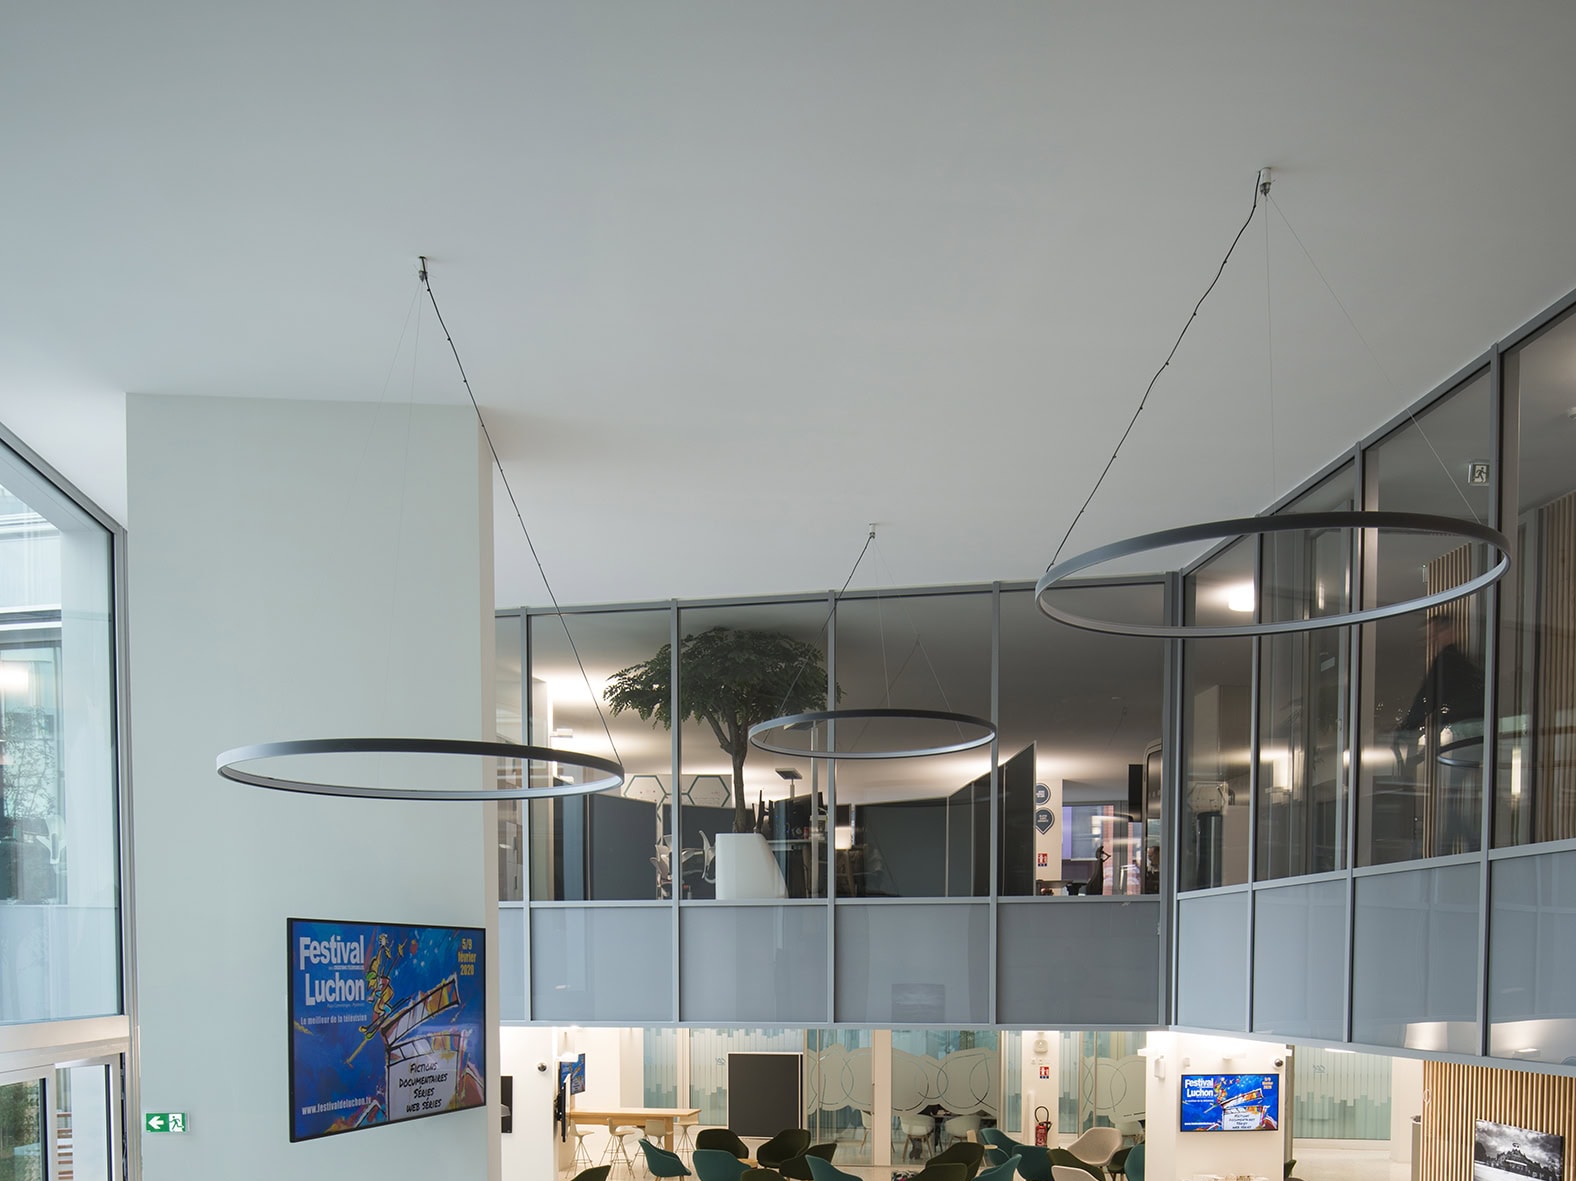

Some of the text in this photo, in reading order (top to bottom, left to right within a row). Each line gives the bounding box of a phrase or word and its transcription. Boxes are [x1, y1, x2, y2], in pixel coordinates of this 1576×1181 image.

[299, 934, 365, 970] Festival
[460, 963, 475, 976] 2020
[305, 972, 365, 1006] Luchon
[1185, 1078, 1214, 1088] Festival
[1187, 1088, 1214, 1097] Luchon
